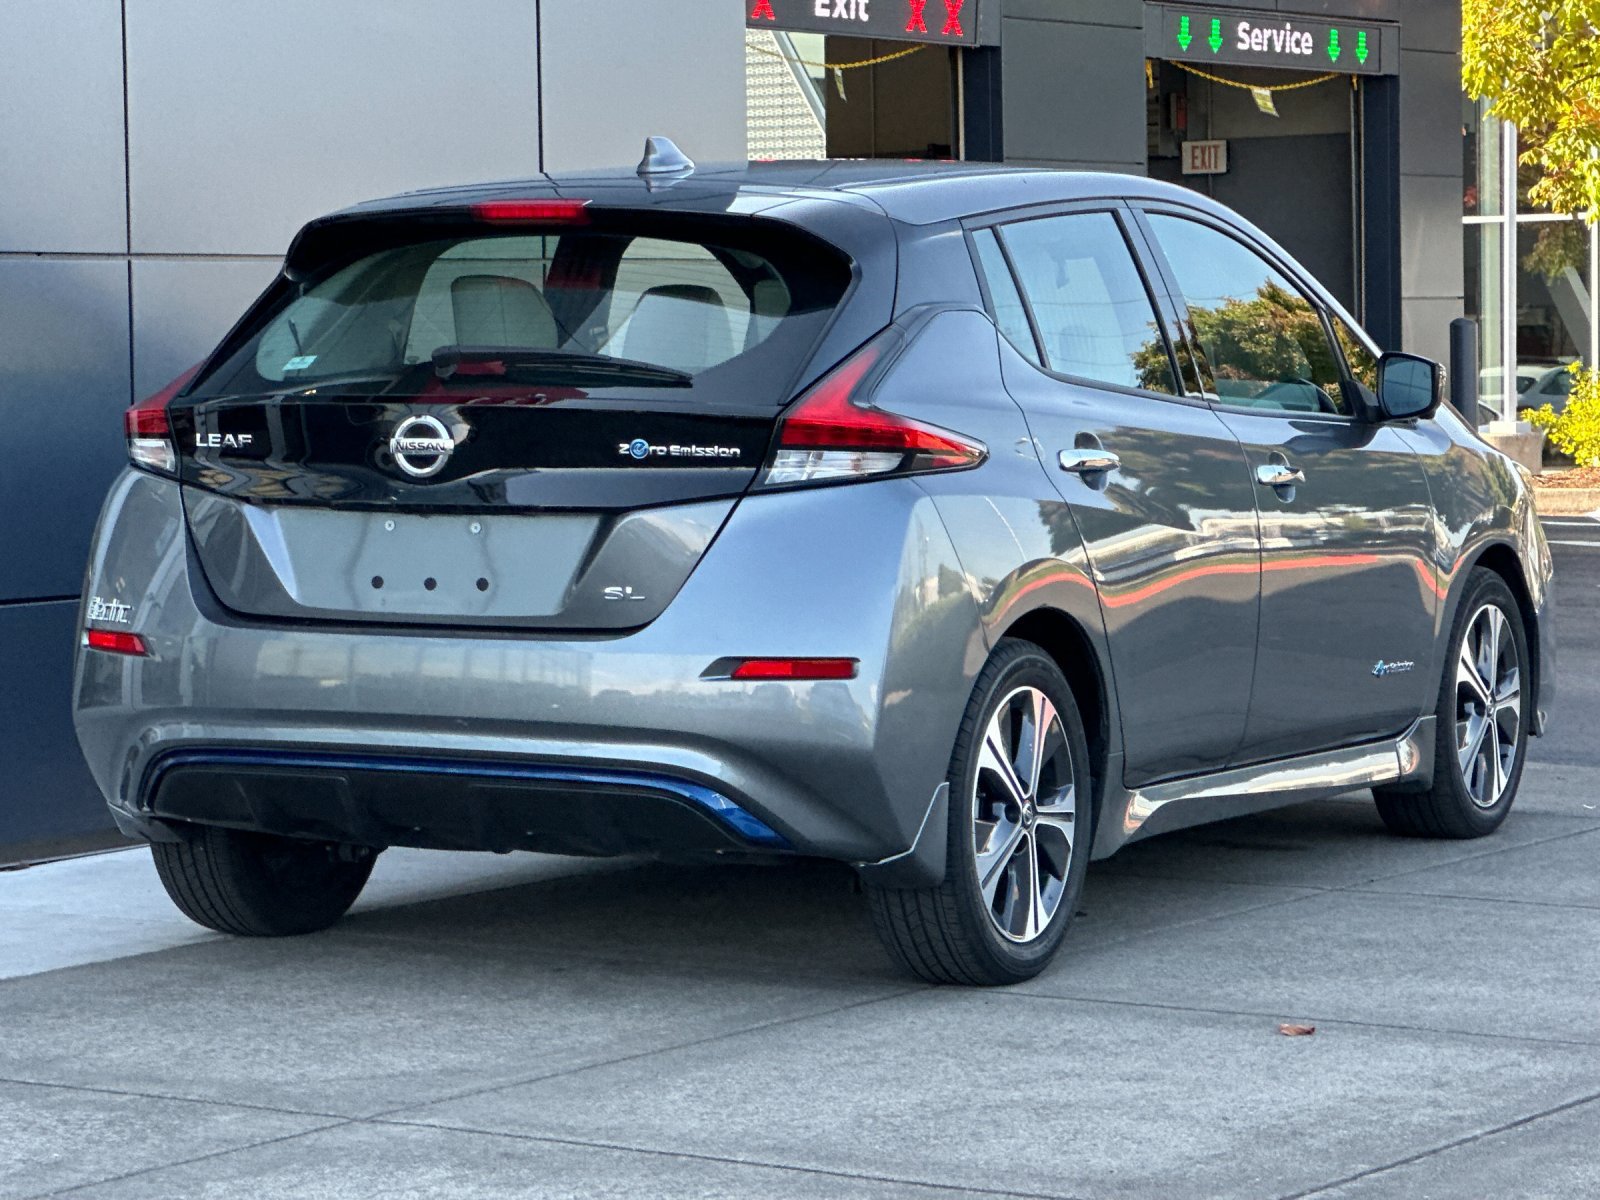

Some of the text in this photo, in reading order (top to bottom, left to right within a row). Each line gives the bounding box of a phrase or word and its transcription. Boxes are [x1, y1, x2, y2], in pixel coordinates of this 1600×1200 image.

[814, 0, 869, 21] Exit
[1236, 21, 1313, 55] Service
[1190, 144, 1221, 171] EXIT
[195, 433, 252, 448] LEAF
[394, 440, 447, 453] NISSAN
[669, 444, 741, 458] Emission
[604, 586, 646, 600] SL
